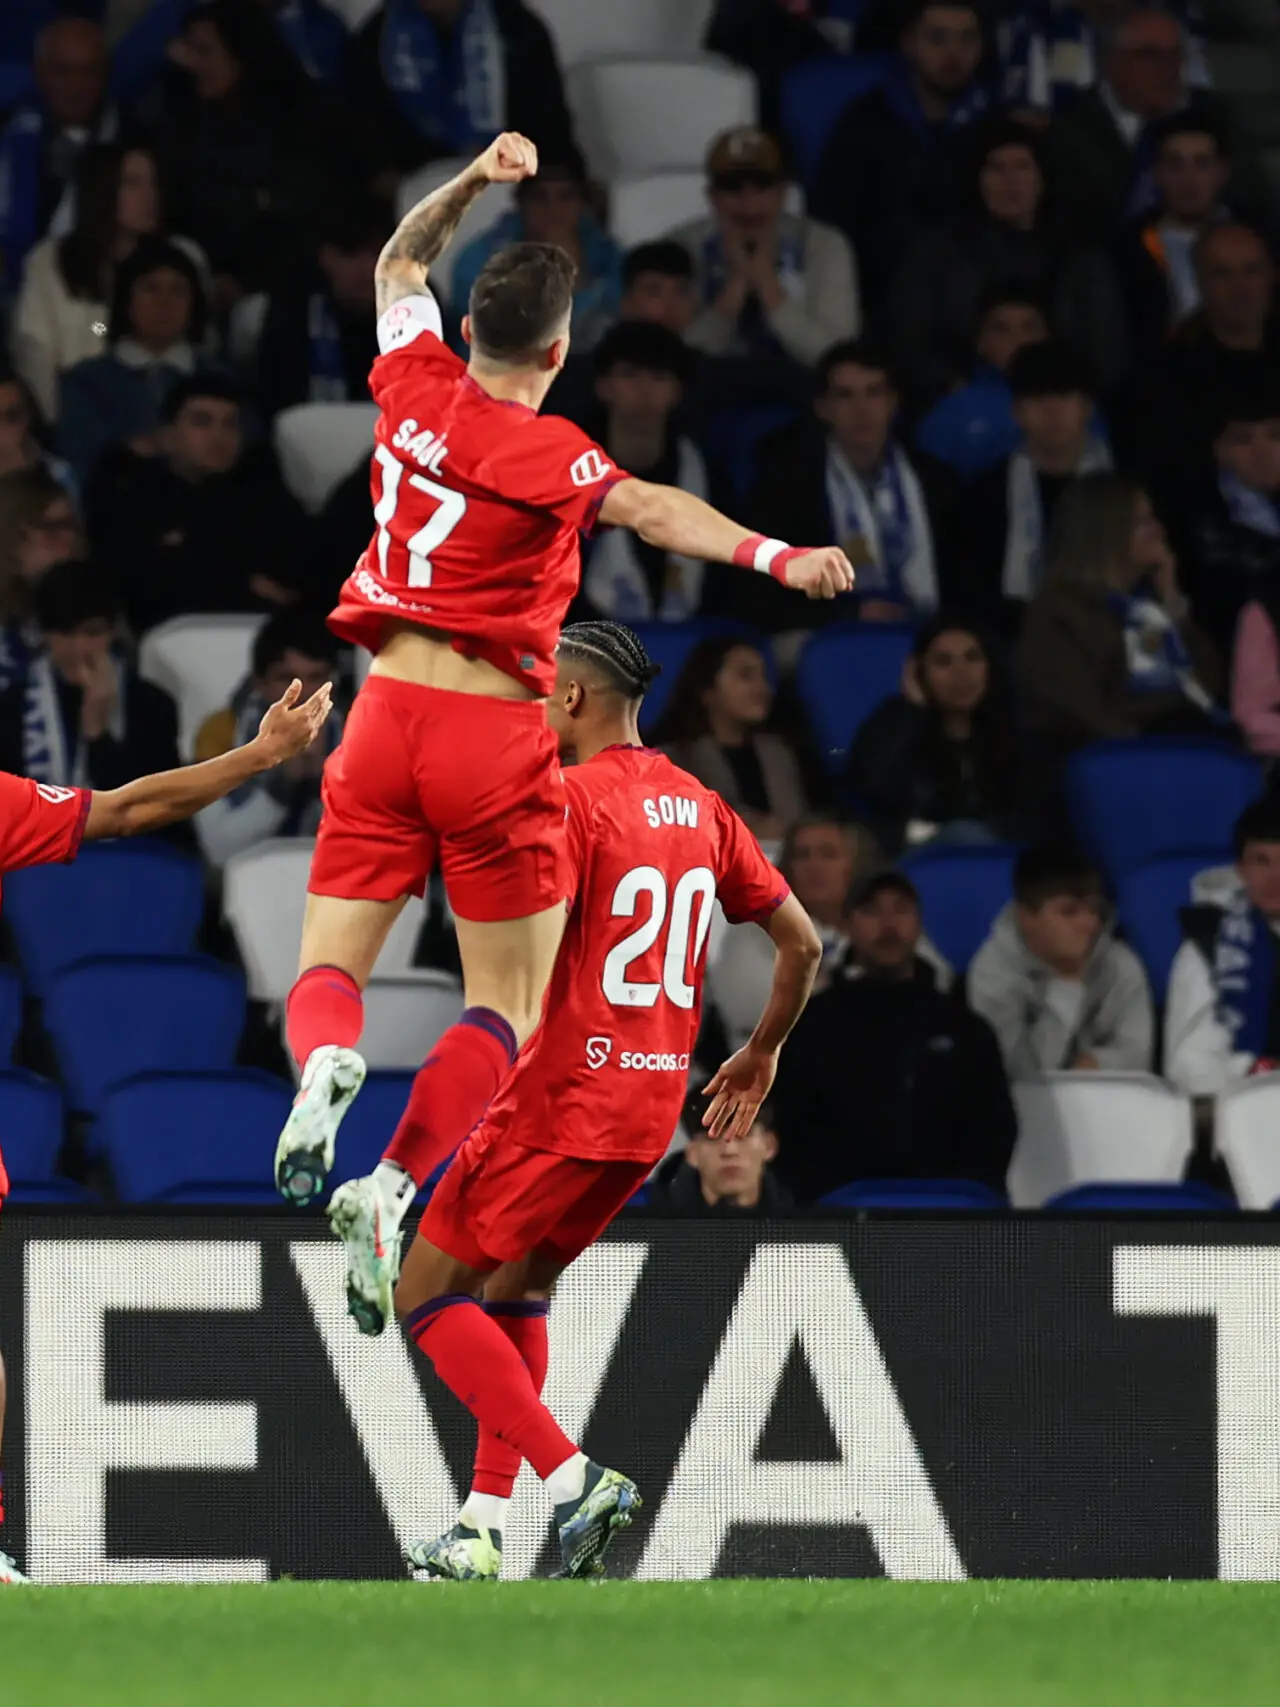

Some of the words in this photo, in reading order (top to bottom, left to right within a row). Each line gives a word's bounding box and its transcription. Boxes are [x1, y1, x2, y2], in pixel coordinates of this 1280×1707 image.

[373, 442, 468, 589] 17
[642, 795, 700, 829] SOW
[601, 864, 718, 1010] 20
